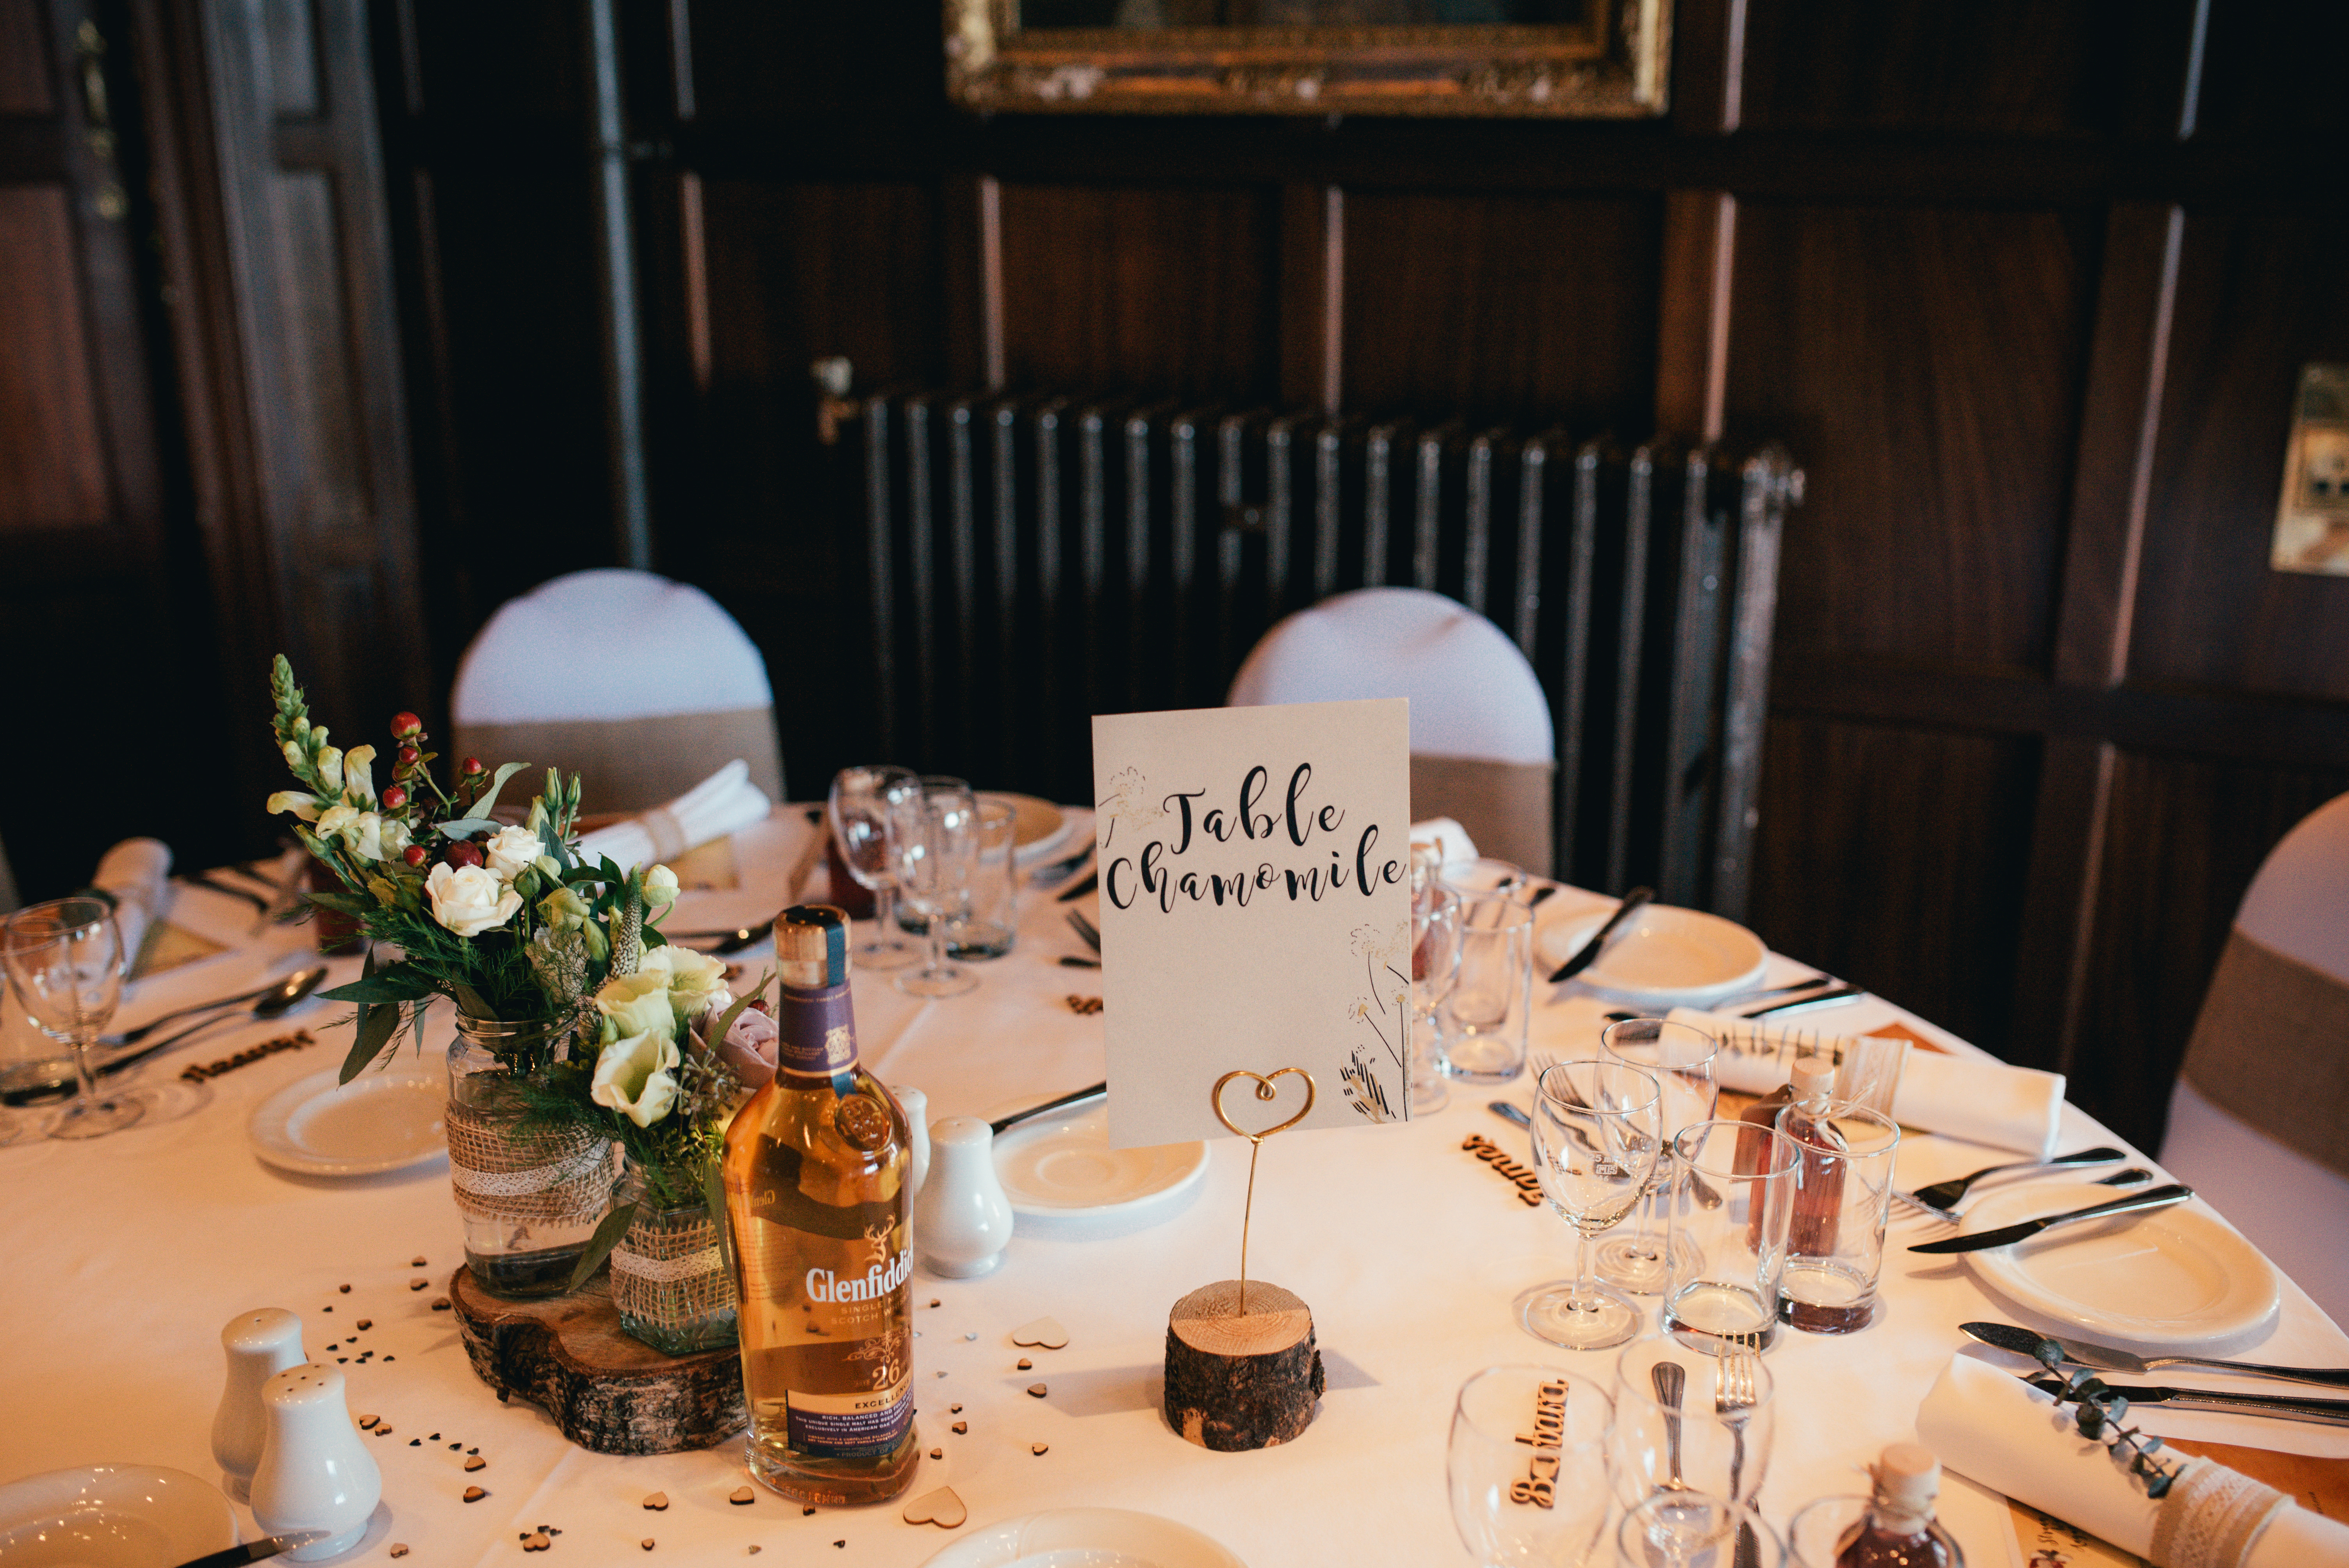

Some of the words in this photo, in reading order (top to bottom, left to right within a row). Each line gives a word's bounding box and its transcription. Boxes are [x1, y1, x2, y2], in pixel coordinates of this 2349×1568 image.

[1163, 763, 1345, 854] Table
[1107, 824, 1406, 913] Chamomile
[831, 1312, 879, 1324] SCOTCH
[841, 1301, 883, 1314] SINGLE
[872, 1358, 900, 1391] 26
[842, 1413, 878, 1421] BALANCED
